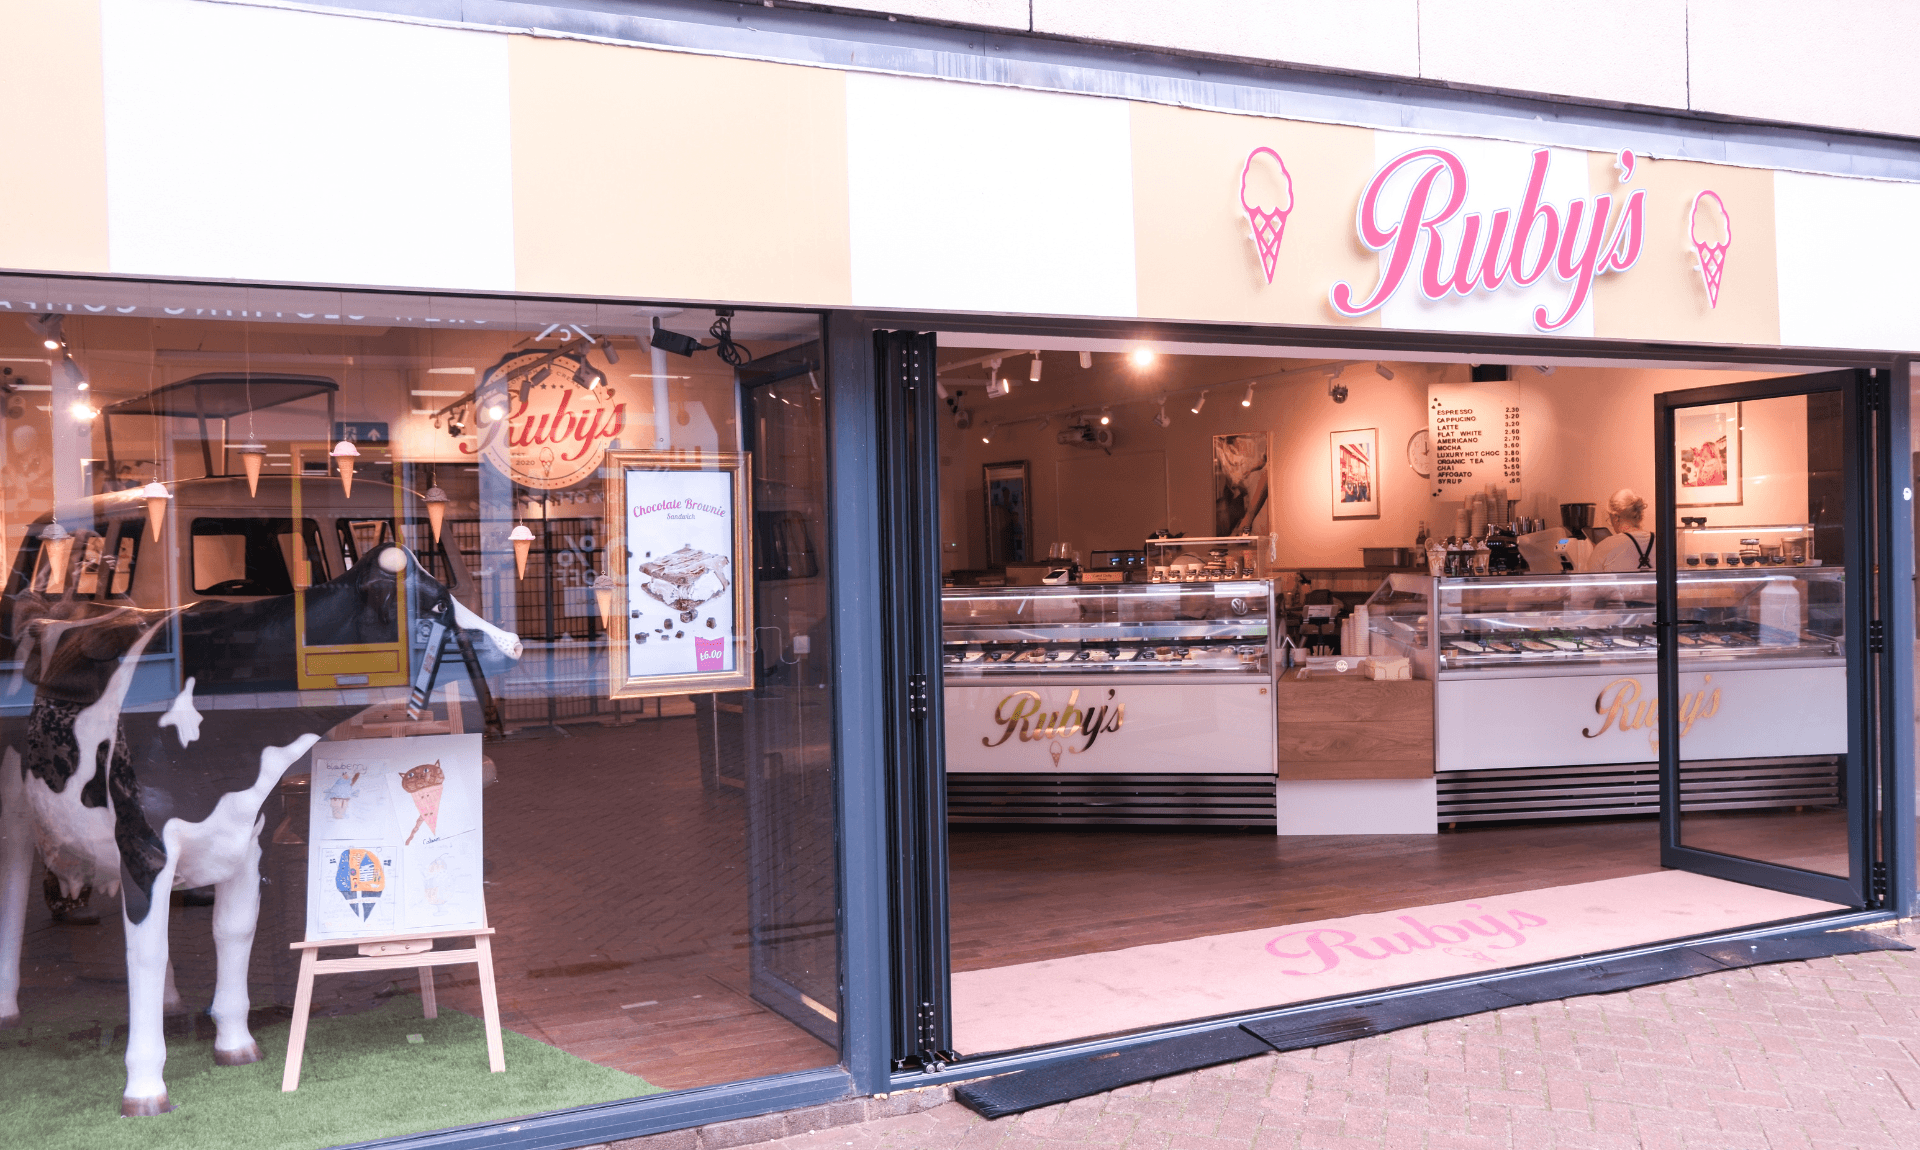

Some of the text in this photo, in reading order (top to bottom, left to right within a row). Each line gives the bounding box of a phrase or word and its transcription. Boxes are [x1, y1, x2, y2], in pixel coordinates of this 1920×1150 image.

[1331, 146, 1646, 332] Ruby's
[459, 387, 627, 462] Ruby's
[1437, 408, 1473, 416] ESPRESSO
[633, 497, 727, 518] Chocolate Brownie
[666, 512, 696, 521] Sandwich
[699, 649, 723, 662] £6.00
[982, 688, 1126, 754] Ruby's
[1582, 674, 1721, 739] Ruy's
[1264, 903, 1549, 976] Ruby's
